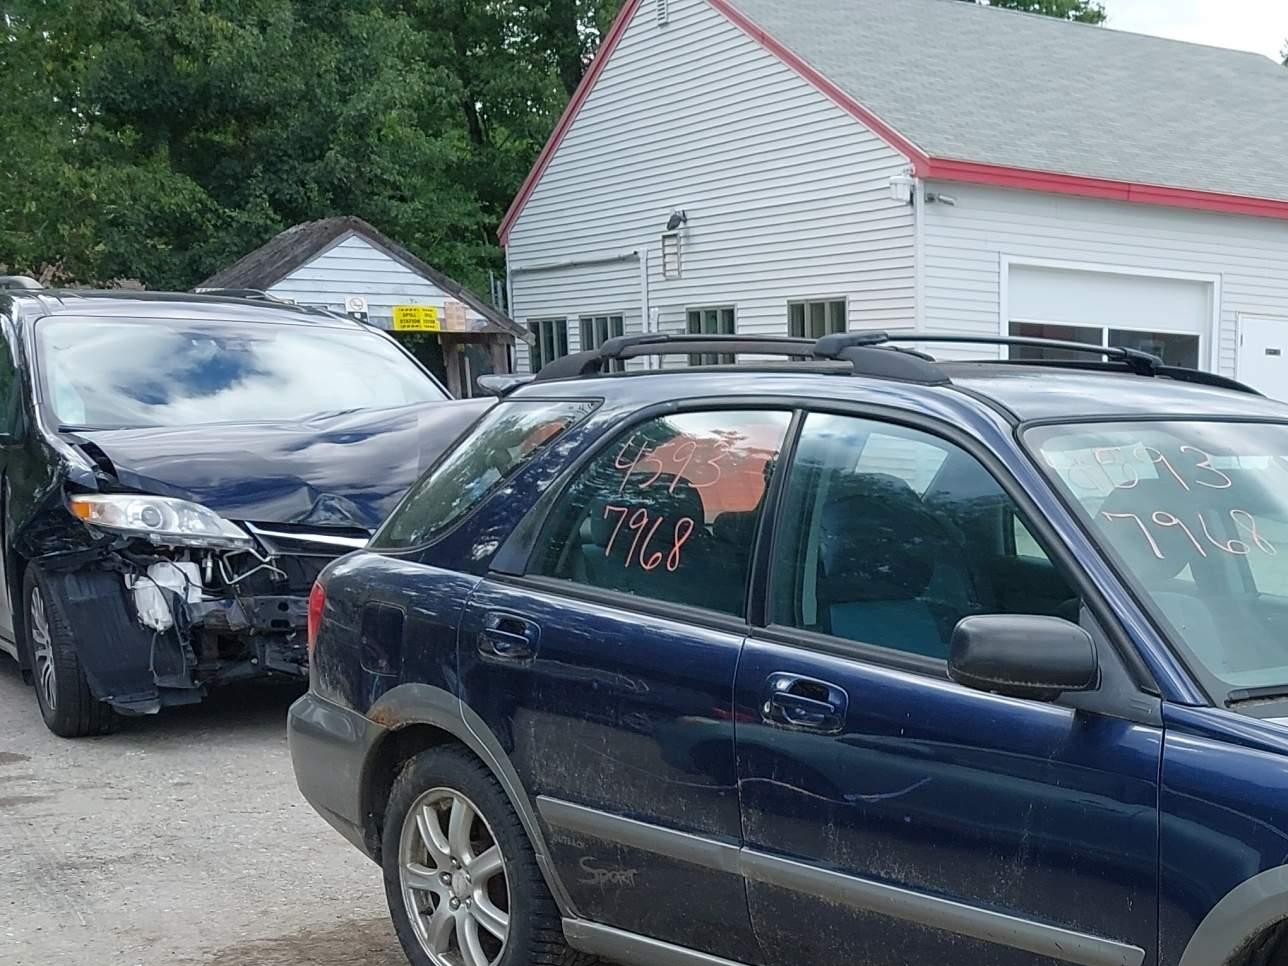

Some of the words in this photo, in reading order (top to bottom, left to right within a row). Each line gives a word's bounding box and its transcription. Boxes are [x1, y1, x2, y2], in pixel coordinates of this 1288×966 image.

[615, 433, 732, 498] 4593
[604, 504, 695, 572] 7968
[1101, 508, 1278, 560] 7968
